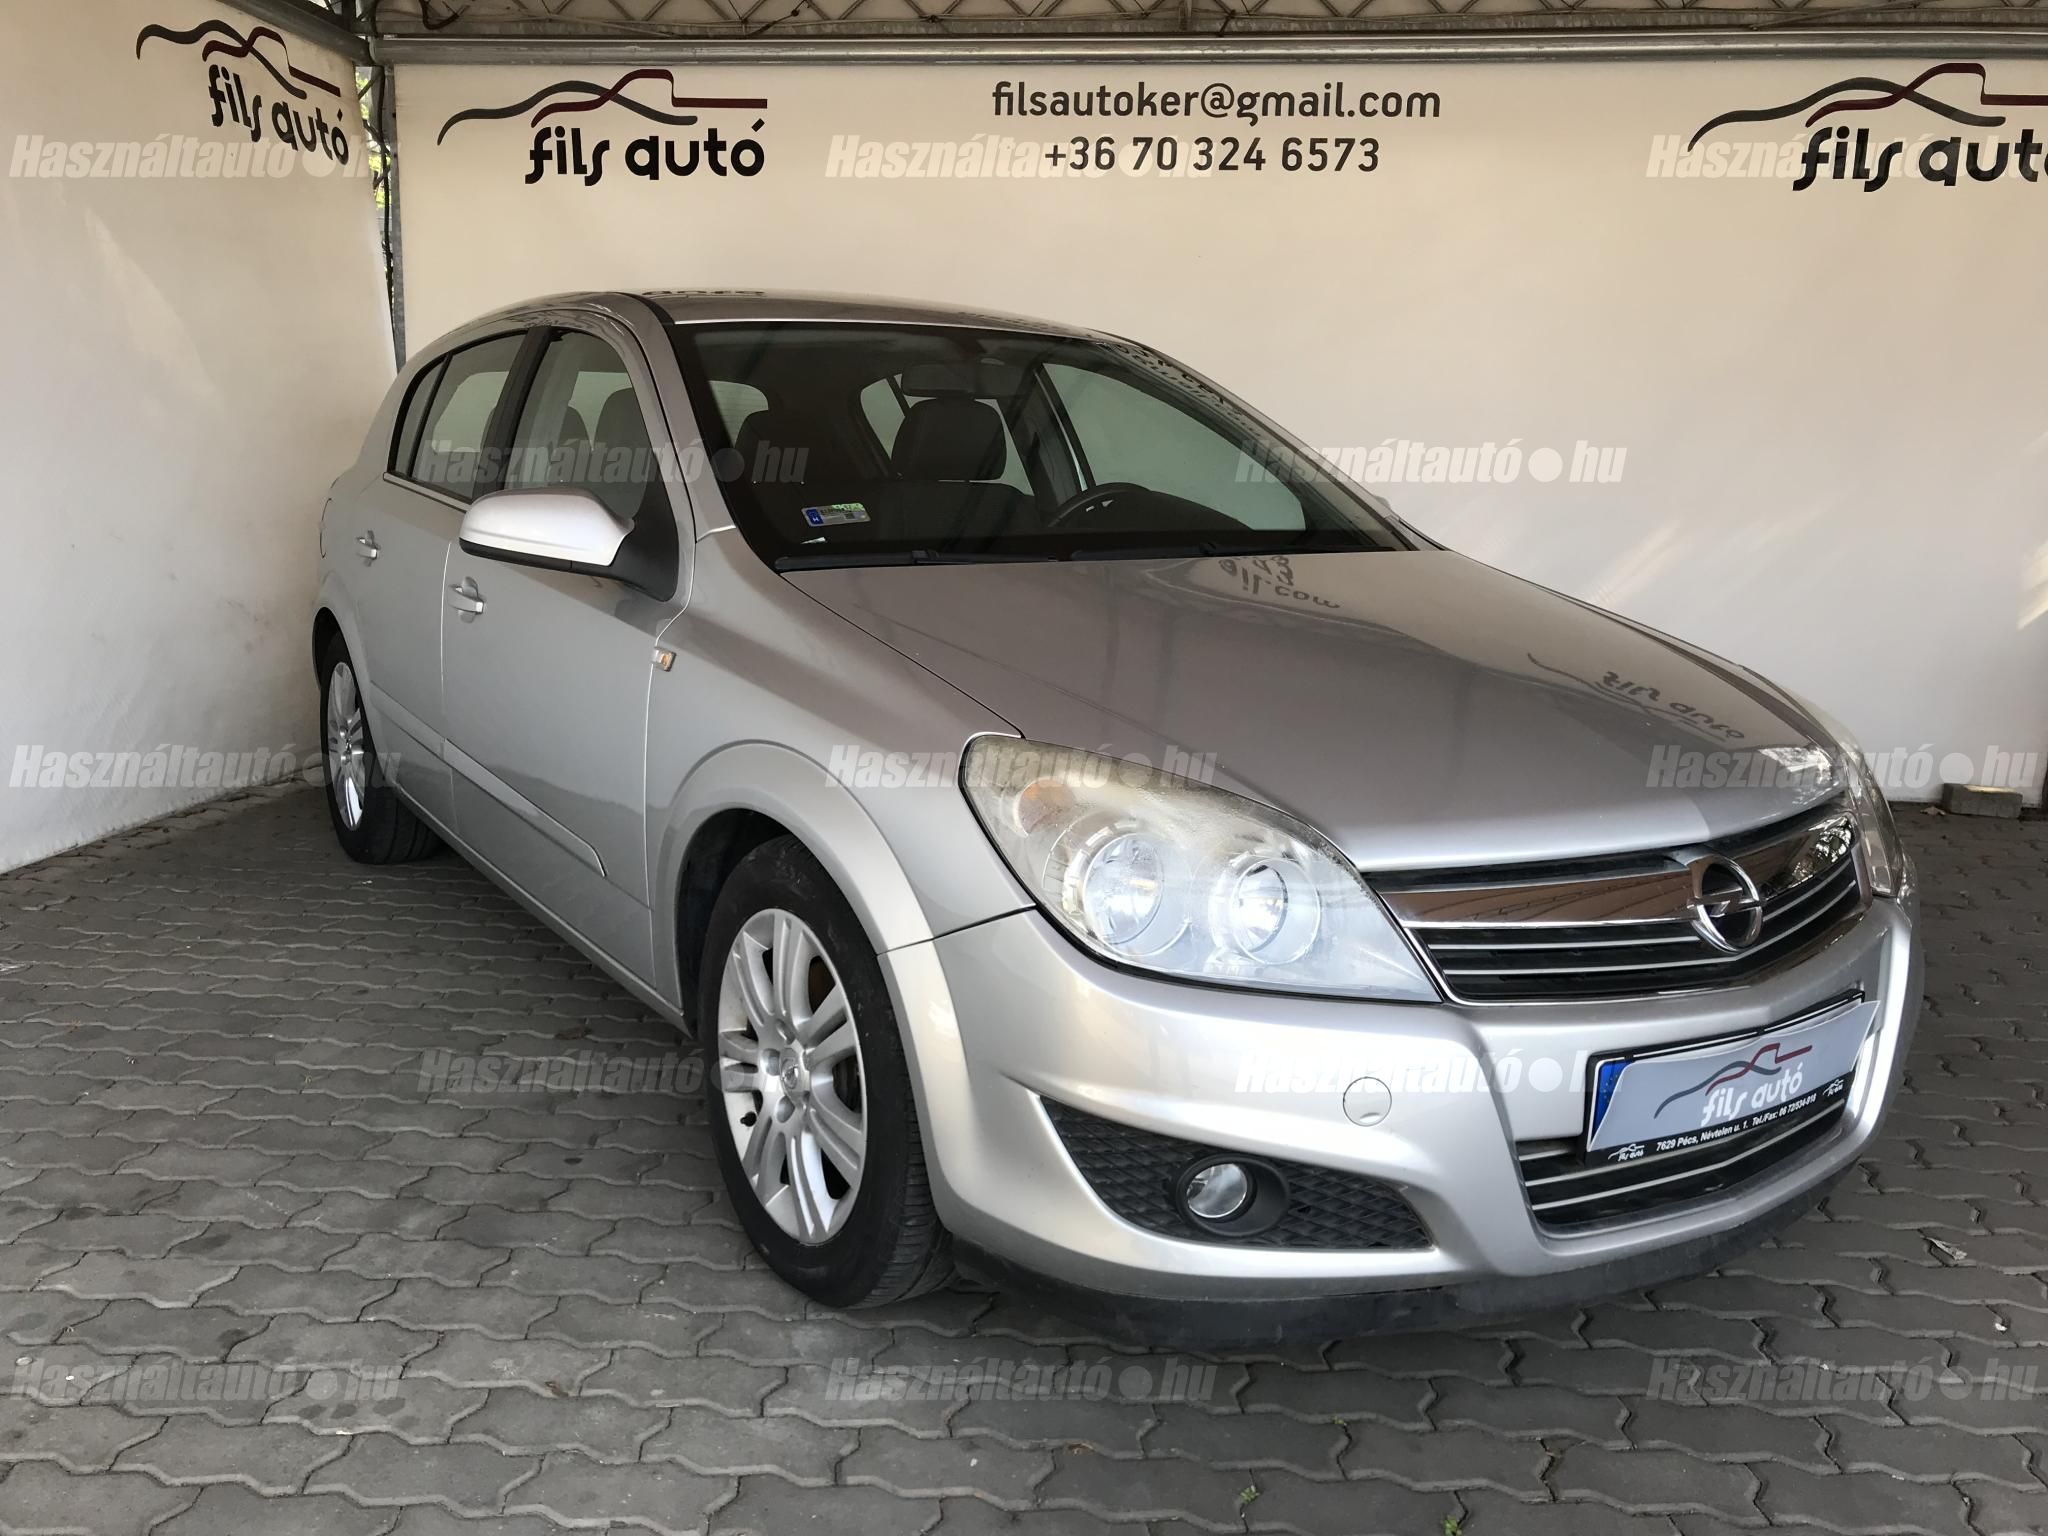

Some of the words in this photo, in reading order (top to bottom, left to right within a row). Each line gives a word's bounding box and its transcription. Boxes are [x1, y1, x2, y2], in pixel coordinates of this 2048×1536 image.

[208, 64, 262, 143] fils
[271, 101, 349, 165] autó
[992, 81, 1441, 127] filsautoker@gmail.com
[525, 125, 610, 187] fils
[624, 118, 766, 180] autó
[1045, 136, 1116, 171] +36
[1132, 136, 1178, 171] 70
[1192, 136, 1266, 171] 324
[1281, 136, 1380, 172] 6573
[1793, 125, 1904, 193] fils
[1918, 128, 2048, 187] aut
[1700, 1086, 1748, 1128] fils
[1751, 1061, 1804, 1109] autó
[1656, 1139, 1676, 1152] 7629
